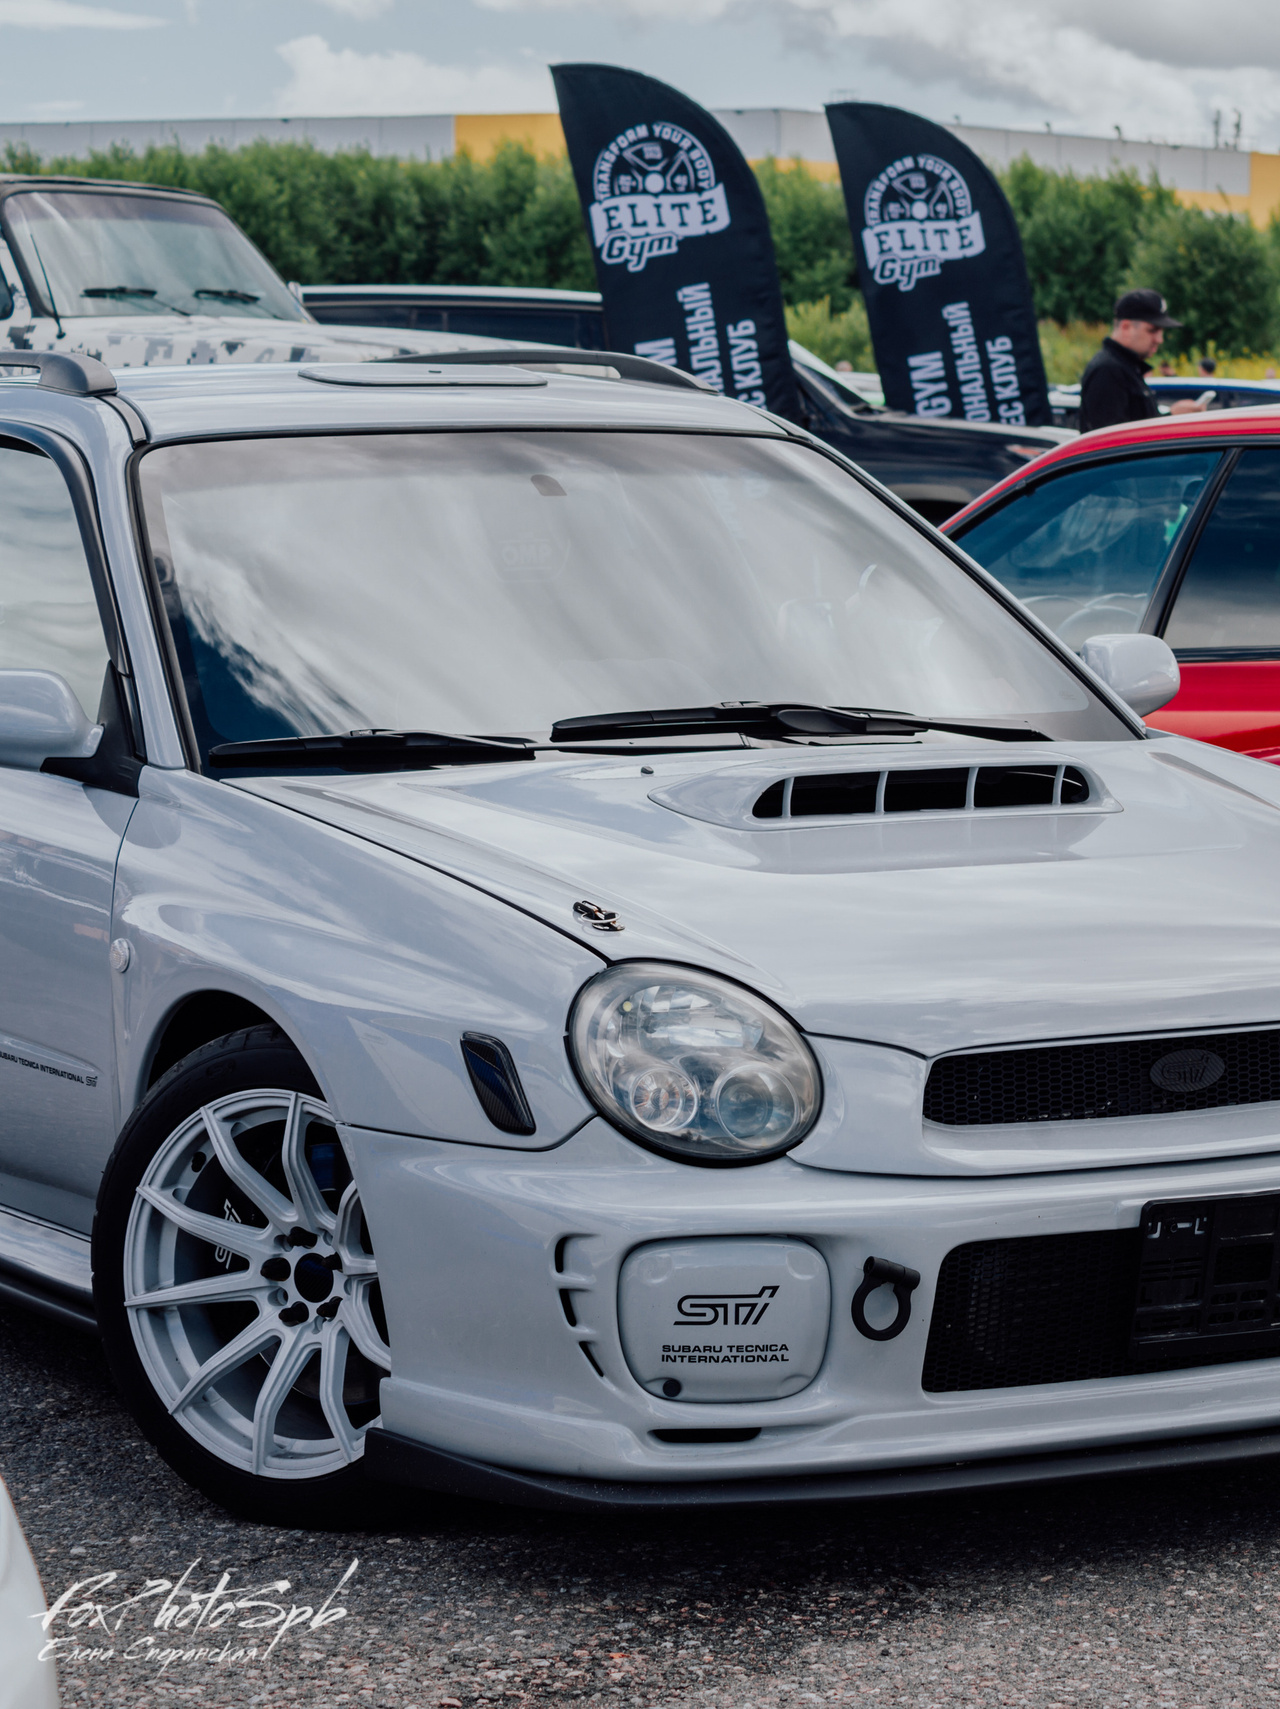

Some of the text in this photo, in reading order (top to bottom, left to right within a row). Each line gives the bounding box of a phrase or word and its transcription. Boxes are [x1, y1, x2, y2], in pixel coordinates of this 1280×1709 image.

[597, 122, 711, 200] TRANSFORM YOUR BODY
[602, 198, 718, 232] ELITE
[604, 233, 676, 269] Gym
[874, 225, 974, 254] ELITE
[876, 256, 938, 289] Gym
[677, 283, 724, 396] АЛЬНЫЙ
[727, 319, 763, 390] КЛУБ
[907, 351, 952, 417] GYM
[987, 335, 1021, 400] КЛУБ
[661, 1344, 789, 1353] SUBARU TECNICA
[661, 1353, 789, 1363] INTERNATIONAL
